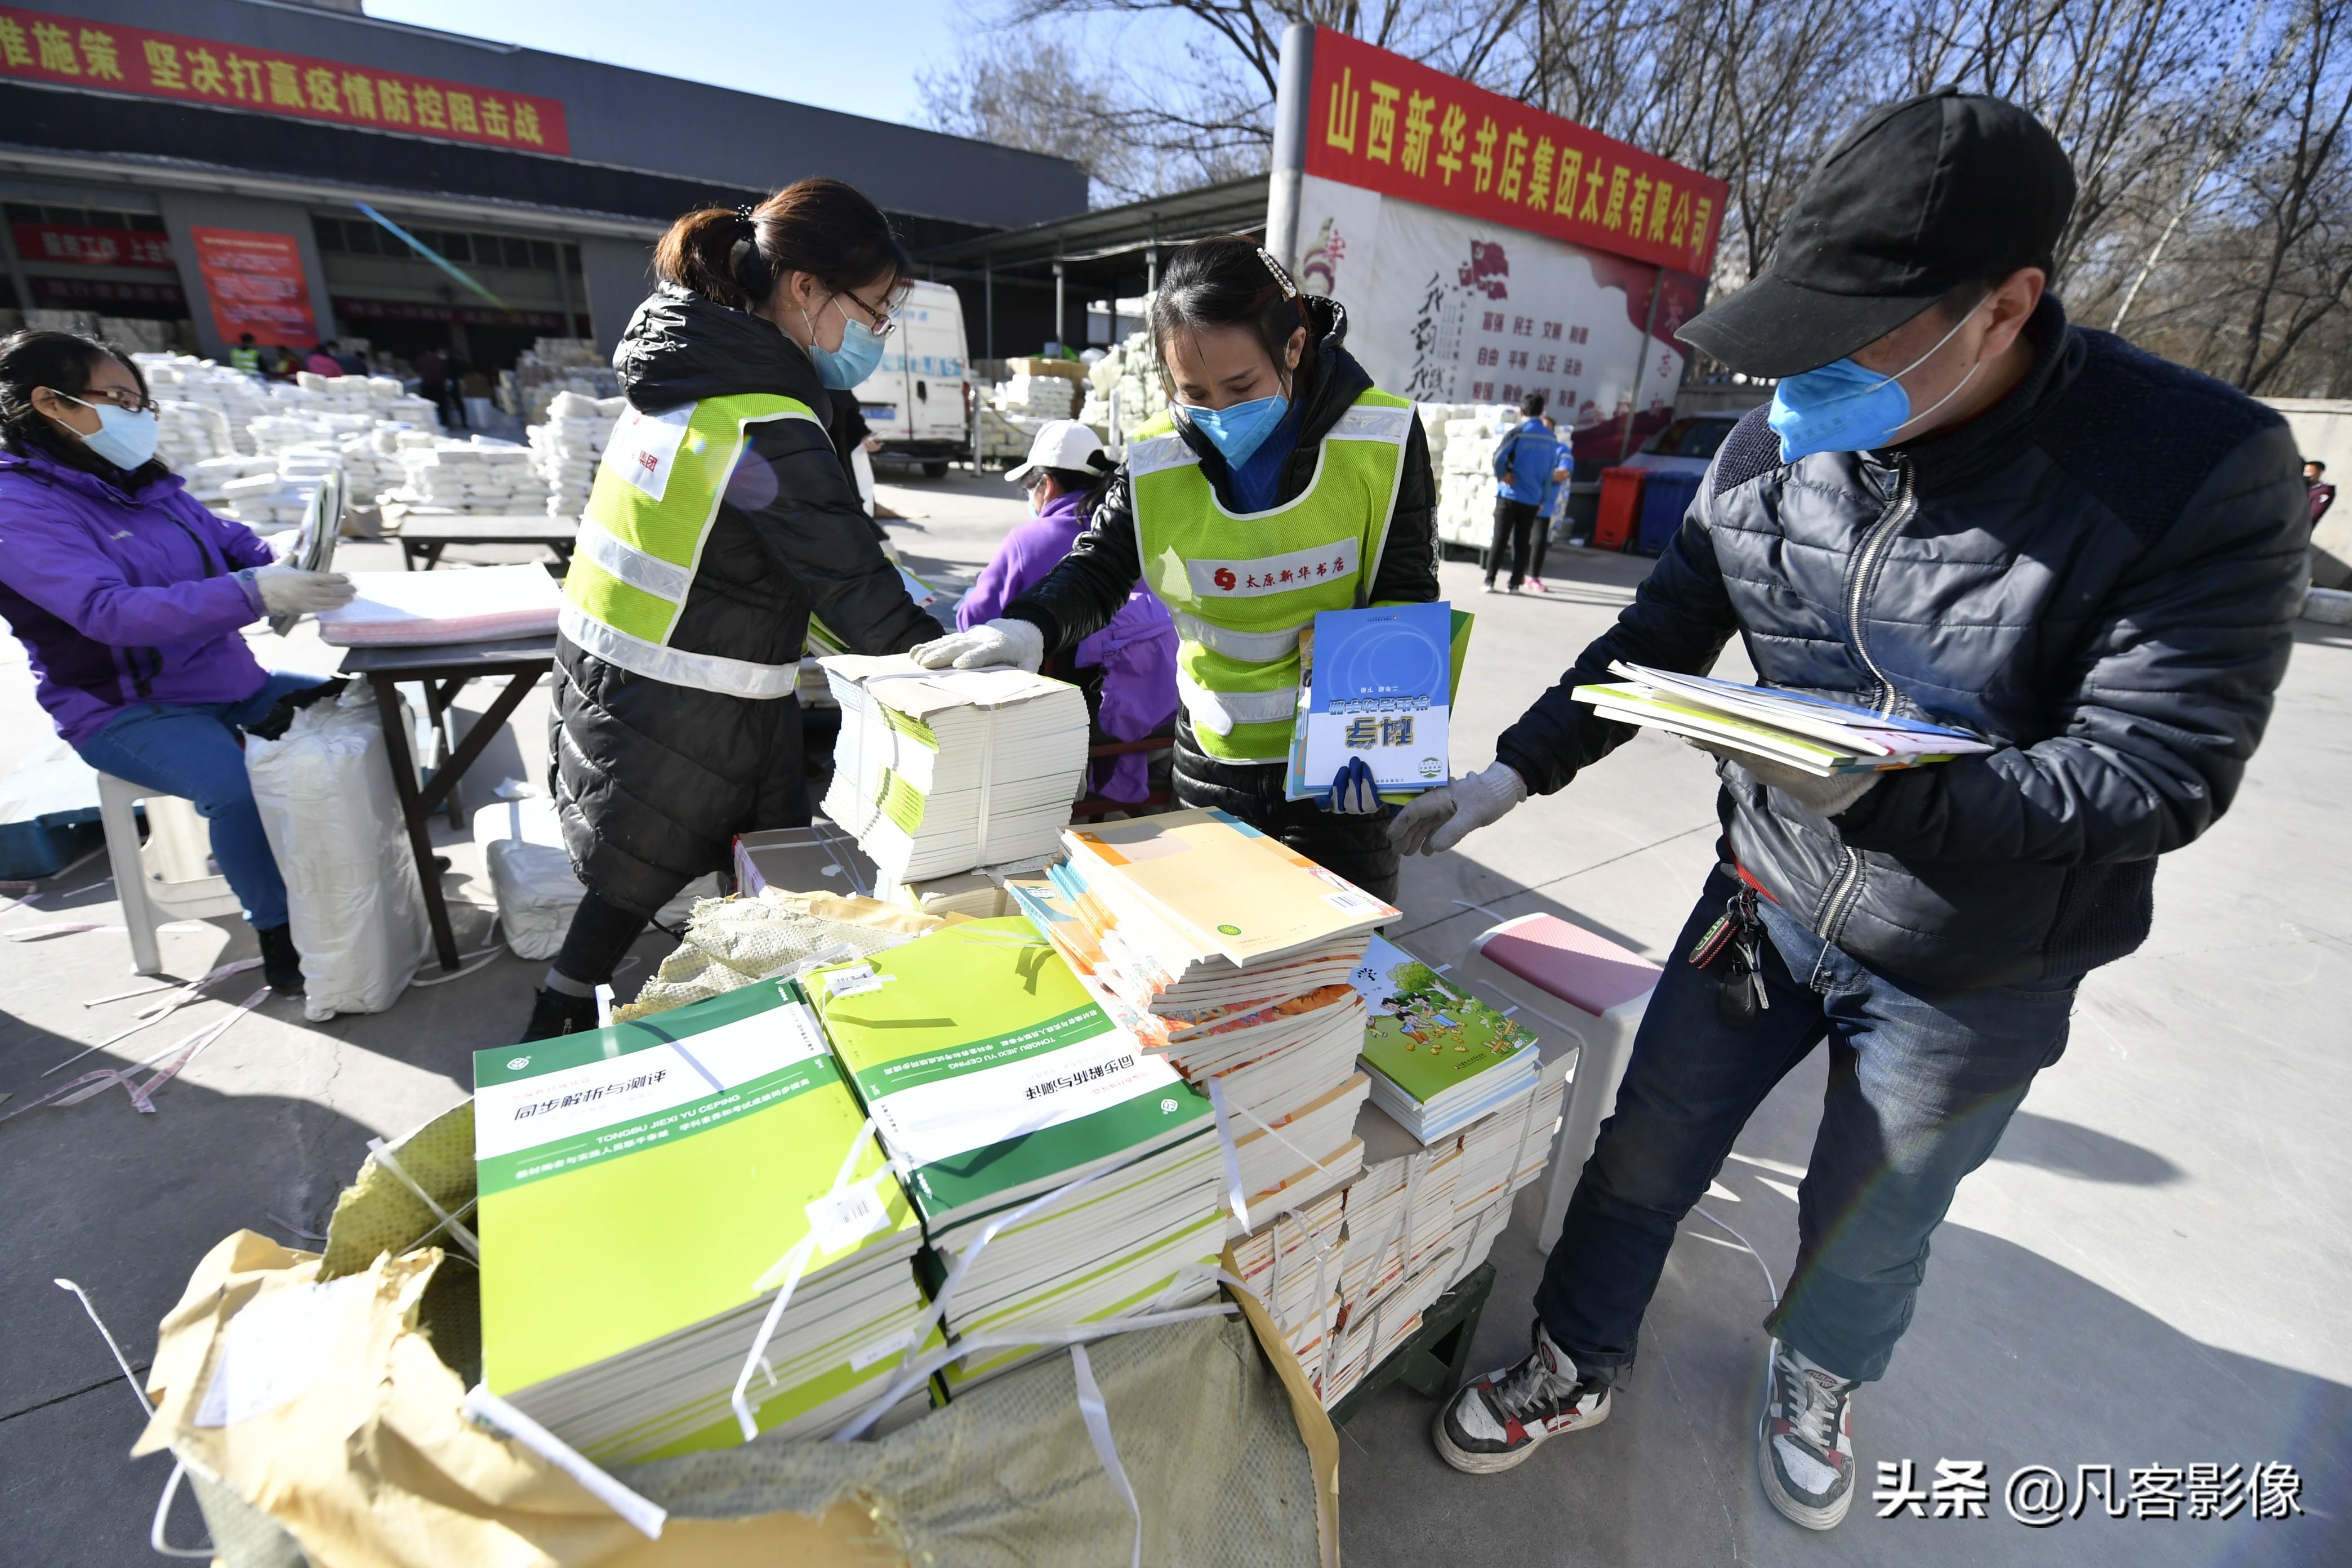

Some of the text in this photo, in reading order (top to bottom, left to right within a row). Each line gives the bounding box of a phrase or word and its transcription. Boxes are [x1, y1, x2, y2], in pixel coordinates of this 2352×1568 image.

[143, 39, 544, 145] 坚决打赢疫情防控阻击战
[1326, 67, 1712, 257] 山西新华书店集团太原有限公司
[1482, 311, 1589, 345] 富强 民主 文明 和谐
[1477, 346, 1583, 376] 自由 平等 公正 法治
[1472, 381, 1494, 400] 爱国
[1503, 384, 1522, 402] 敬业
[1559, 390, 1576, 407] 友善
[638, 450, 658, 473] 集团
[1246, 556, 1344, 589] 太原新华书店
[1329, 695, 1431, 715] 学生活动手册
[1345, 716, 1414, 750] 科学
[997, 1048, 1018, 1057] JIEXI
[1020, 1037, 1055, 1052] TONGBU
[948, 1057, 983, 1070] CEPING
[1026, 1054, 1134, 1102] 同步解析与测评
[514, 1069, 667, 1121] 同步解析与测评
[596, 1093, 741, 1144] TONGBU JIEXI YU CEPING
